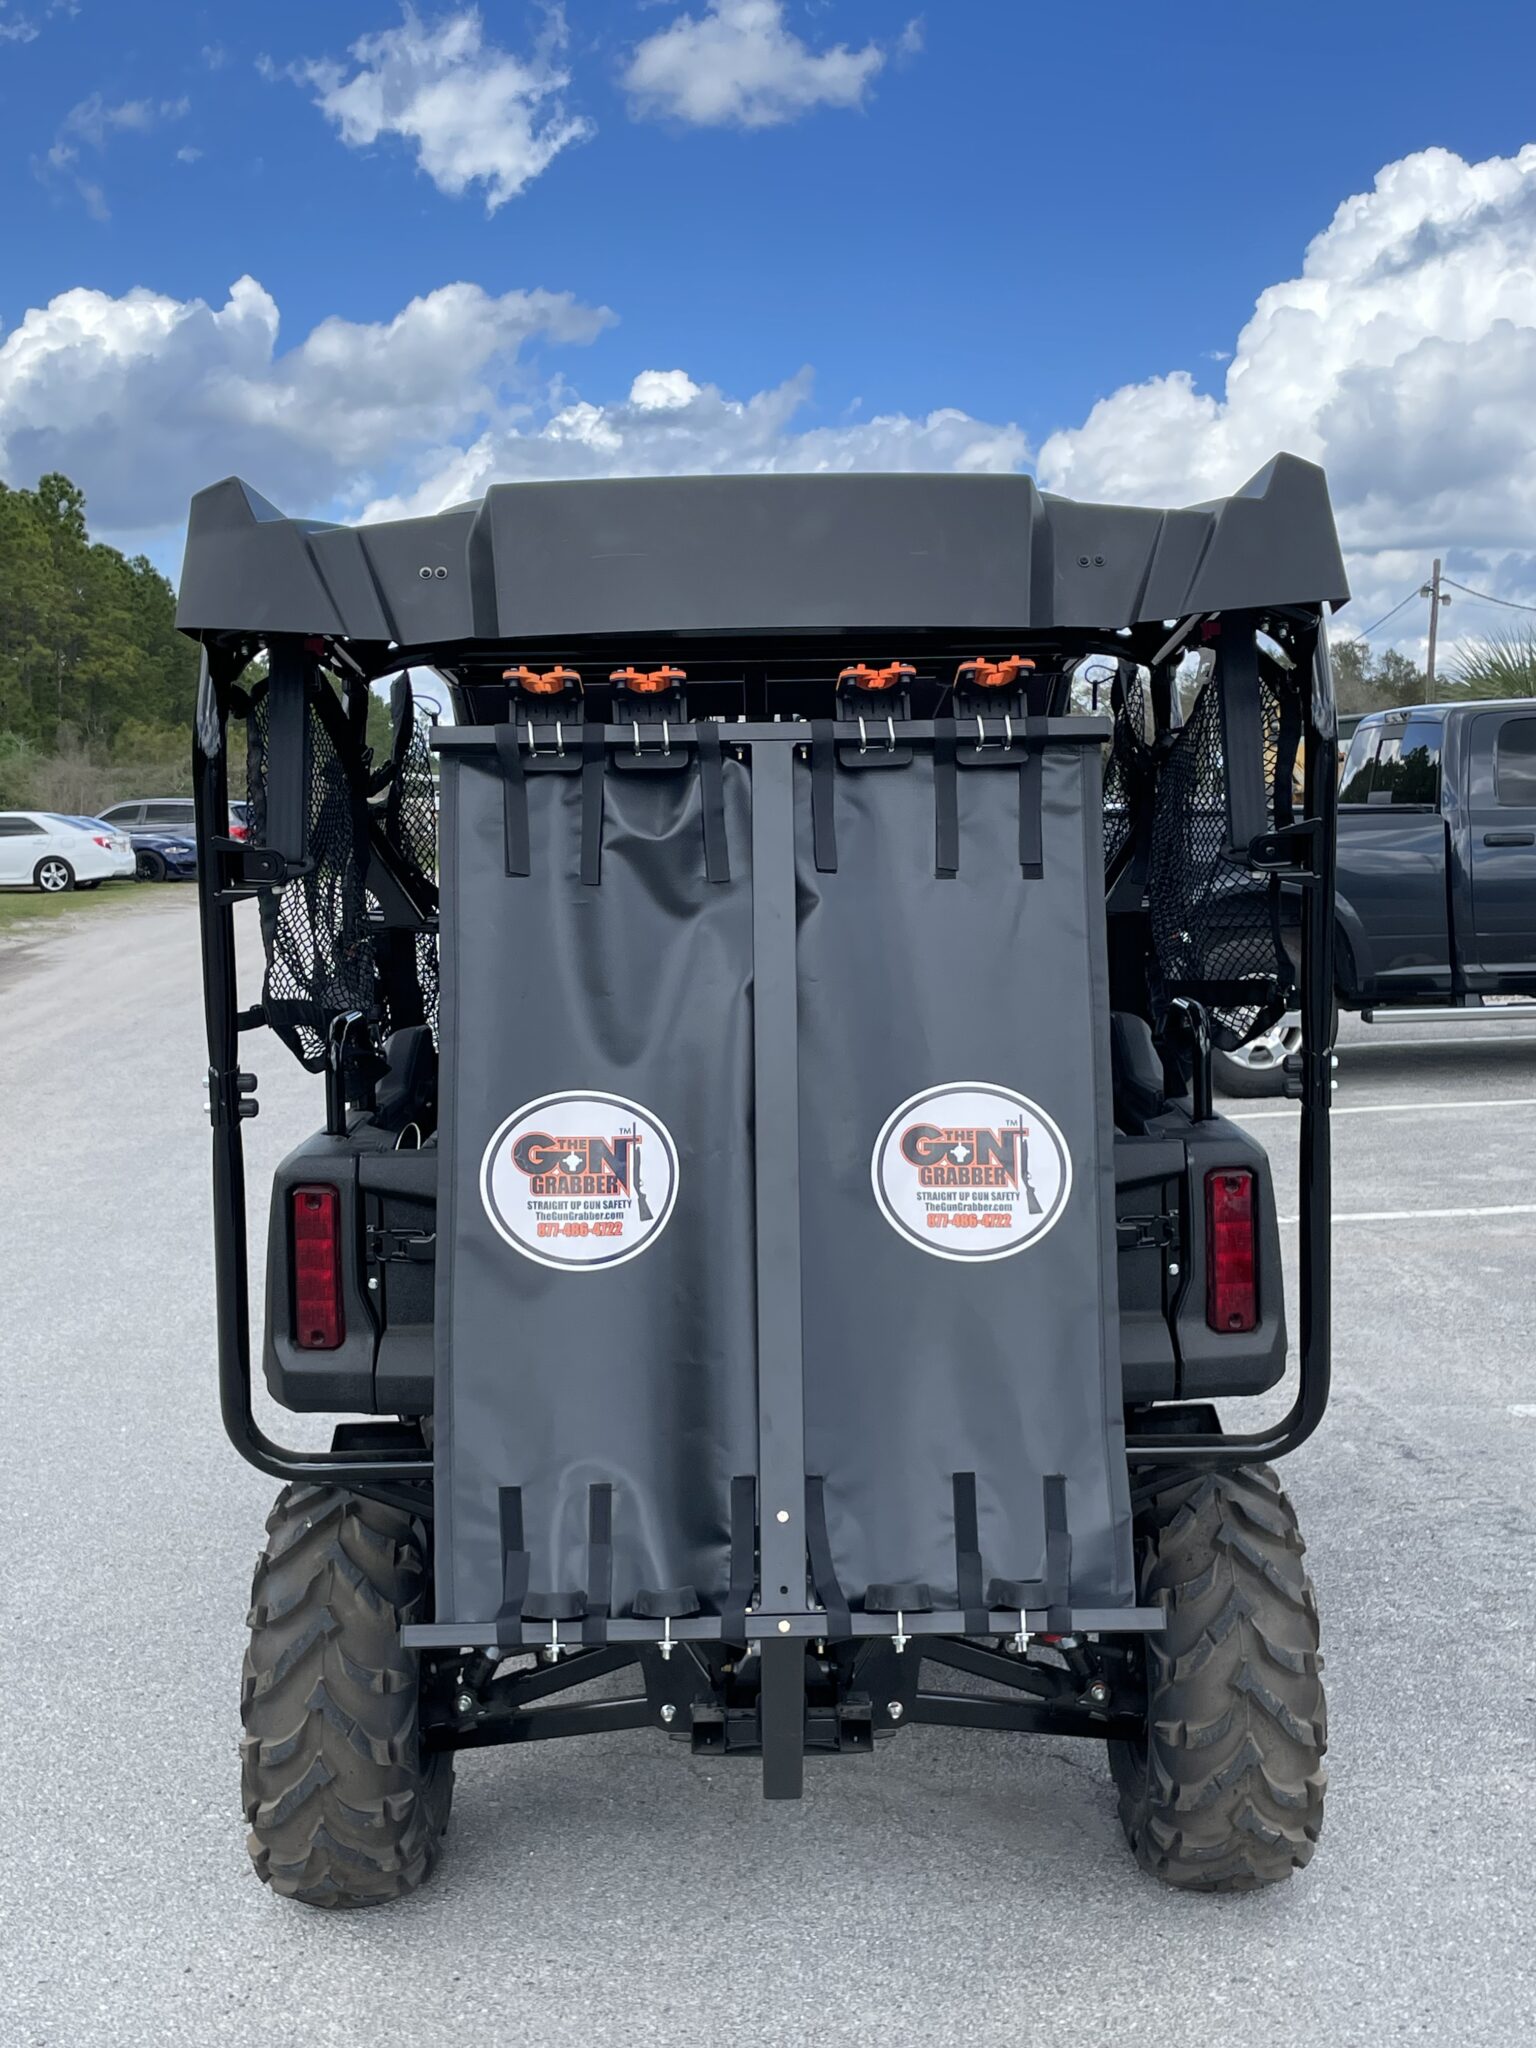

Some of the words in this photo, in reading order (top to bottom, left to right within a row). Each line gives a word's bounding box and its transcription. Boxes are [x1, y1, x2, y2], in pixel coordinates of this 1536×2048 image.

[945, 1131, 974, 1141] THE
[558, 1139, 587, 1150] THE
[900, 1123, 1029, 1190] GUN
[512, 1131, 642, 1198] GUN
[920, 1167, 1007, 1186] GRABBER
[531, 1175, 619, 1195] GRABBER
[916, 1191, 957, 1201] STRAIGHT
[959, 1191, 970, 1201] UP
[972, 1191, 989, 1201] GUN
[991, 1191, 1020, 1201] SAFETY
[527, 1200, 569, 1210] STRAIGHT
[570, 1200, 581, 1210] UP
[583, 1200, 601, 1210] GUN
[602, 1199, 632, 1210] SAFETY
[925, 1202, 1012, 1212] TheGunGrabber.com
[536, 1211, 624, 1221] TheGunGrabber.com
[927, 1213, 1012, 1228] 877-486-4722
[537, 1222, 623, 1237] 877-486-4722
